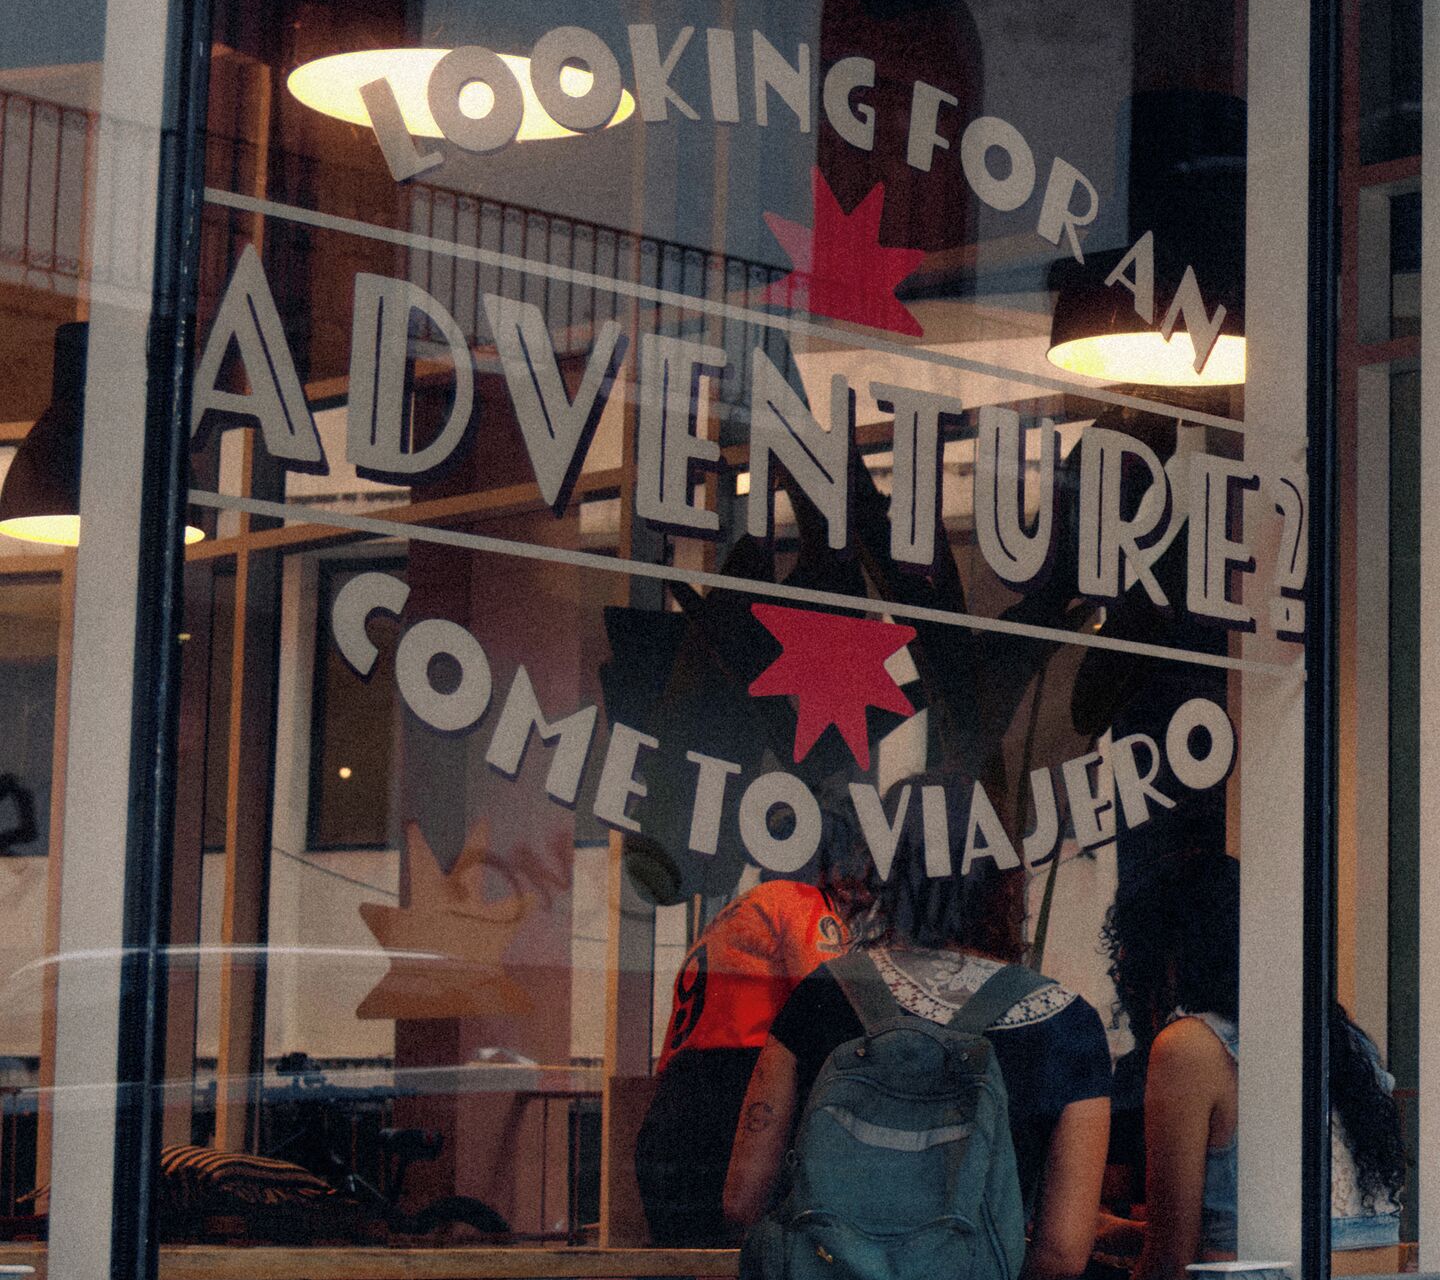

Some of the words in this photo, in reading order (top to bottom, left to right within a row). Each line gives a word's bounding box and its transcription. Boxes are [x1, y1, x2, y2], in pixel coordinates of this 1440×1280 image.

[357, 23, 876, 182] LOOKING
[904, 80, 1101, 264] FOR
[1104, 229, 1228, 375] AN
[191, 243, 1312, 641] ADVENTURE?
[331, 572, 660, 842] COME
[686, 748, 825, 875] TO
[848, 696, 1237, 880] VIAJERO
